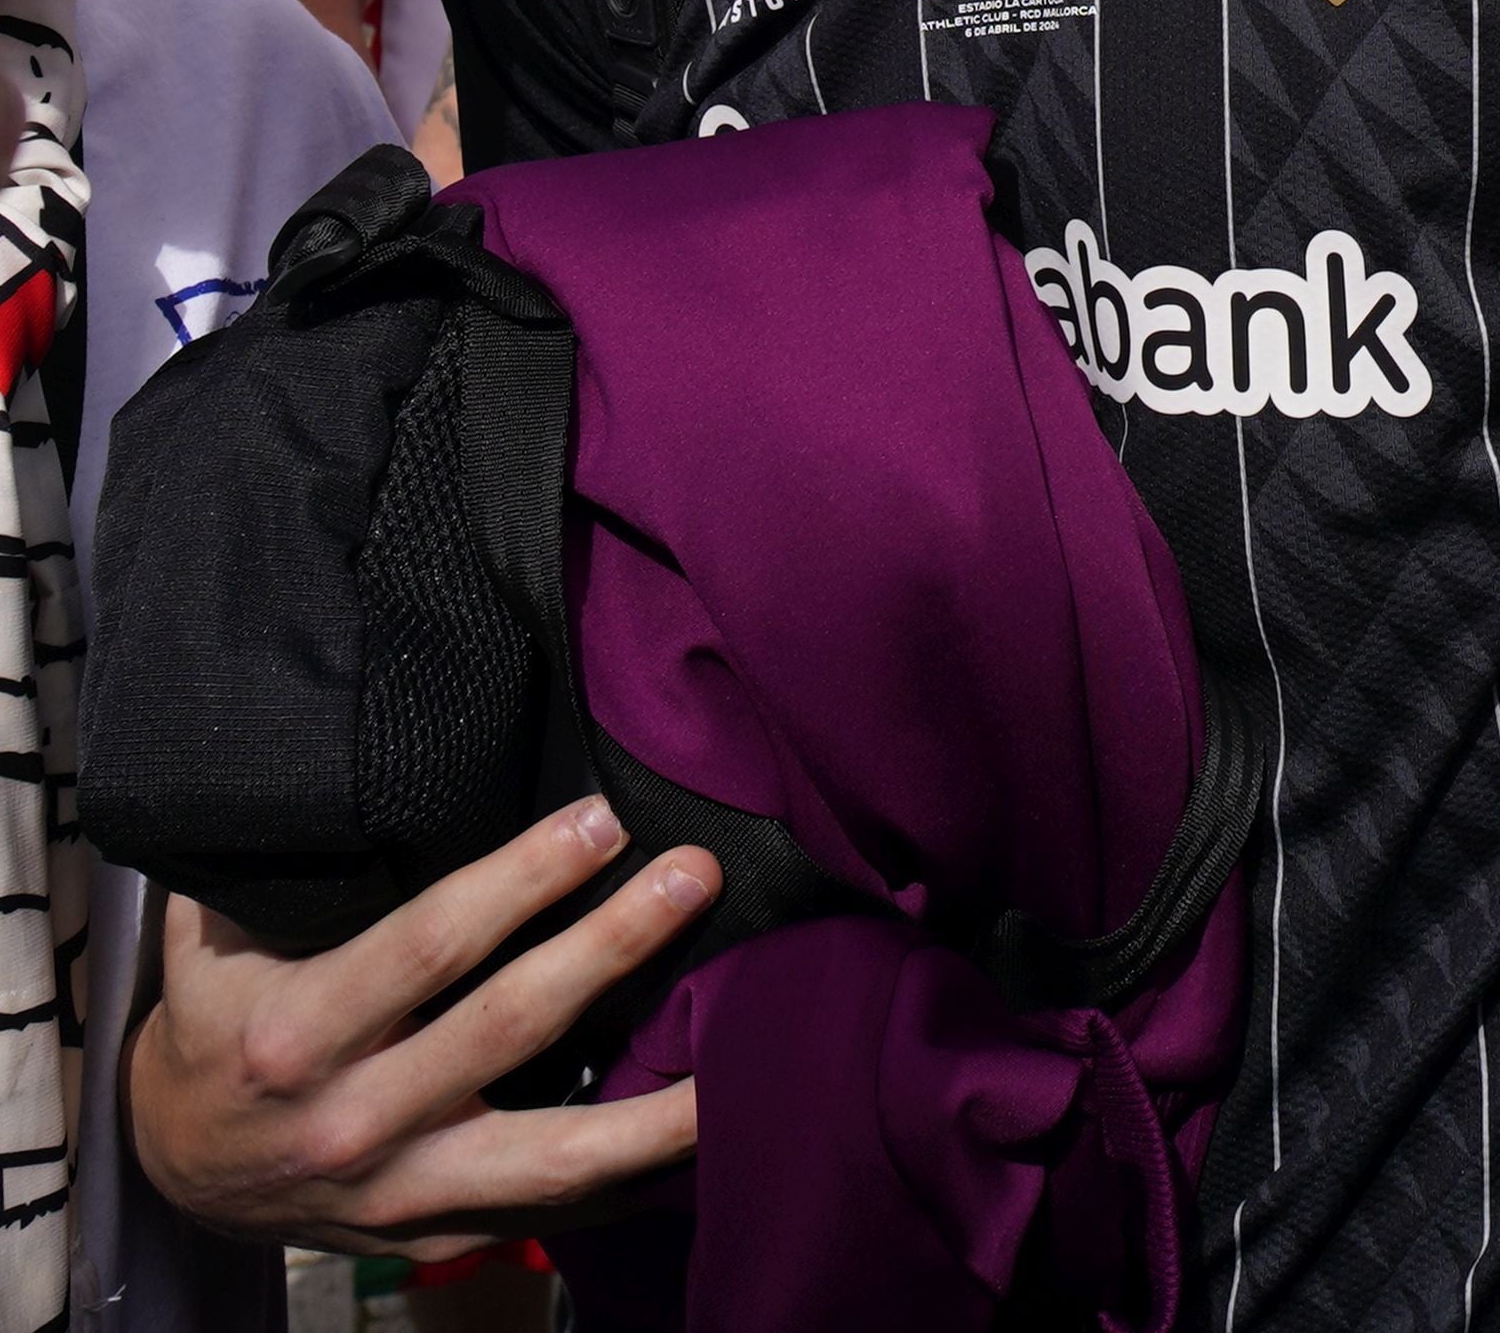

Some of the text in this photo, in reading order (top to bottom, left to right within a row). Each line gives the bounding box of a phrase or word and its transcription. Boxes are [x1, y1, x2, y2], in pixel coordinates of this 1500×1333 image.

[958, 0, 1002, 14] ESTADIO
[919, 12, 980, 32] ATHLETIC
[981, 10, 1010, 24] CLUB
[1019, 9, 1042, 19] RCD
[1043, 5, 1098, 18] MALLORCA
[964, 20, 1060, 38] 6 DE ABRIL DE 2024
